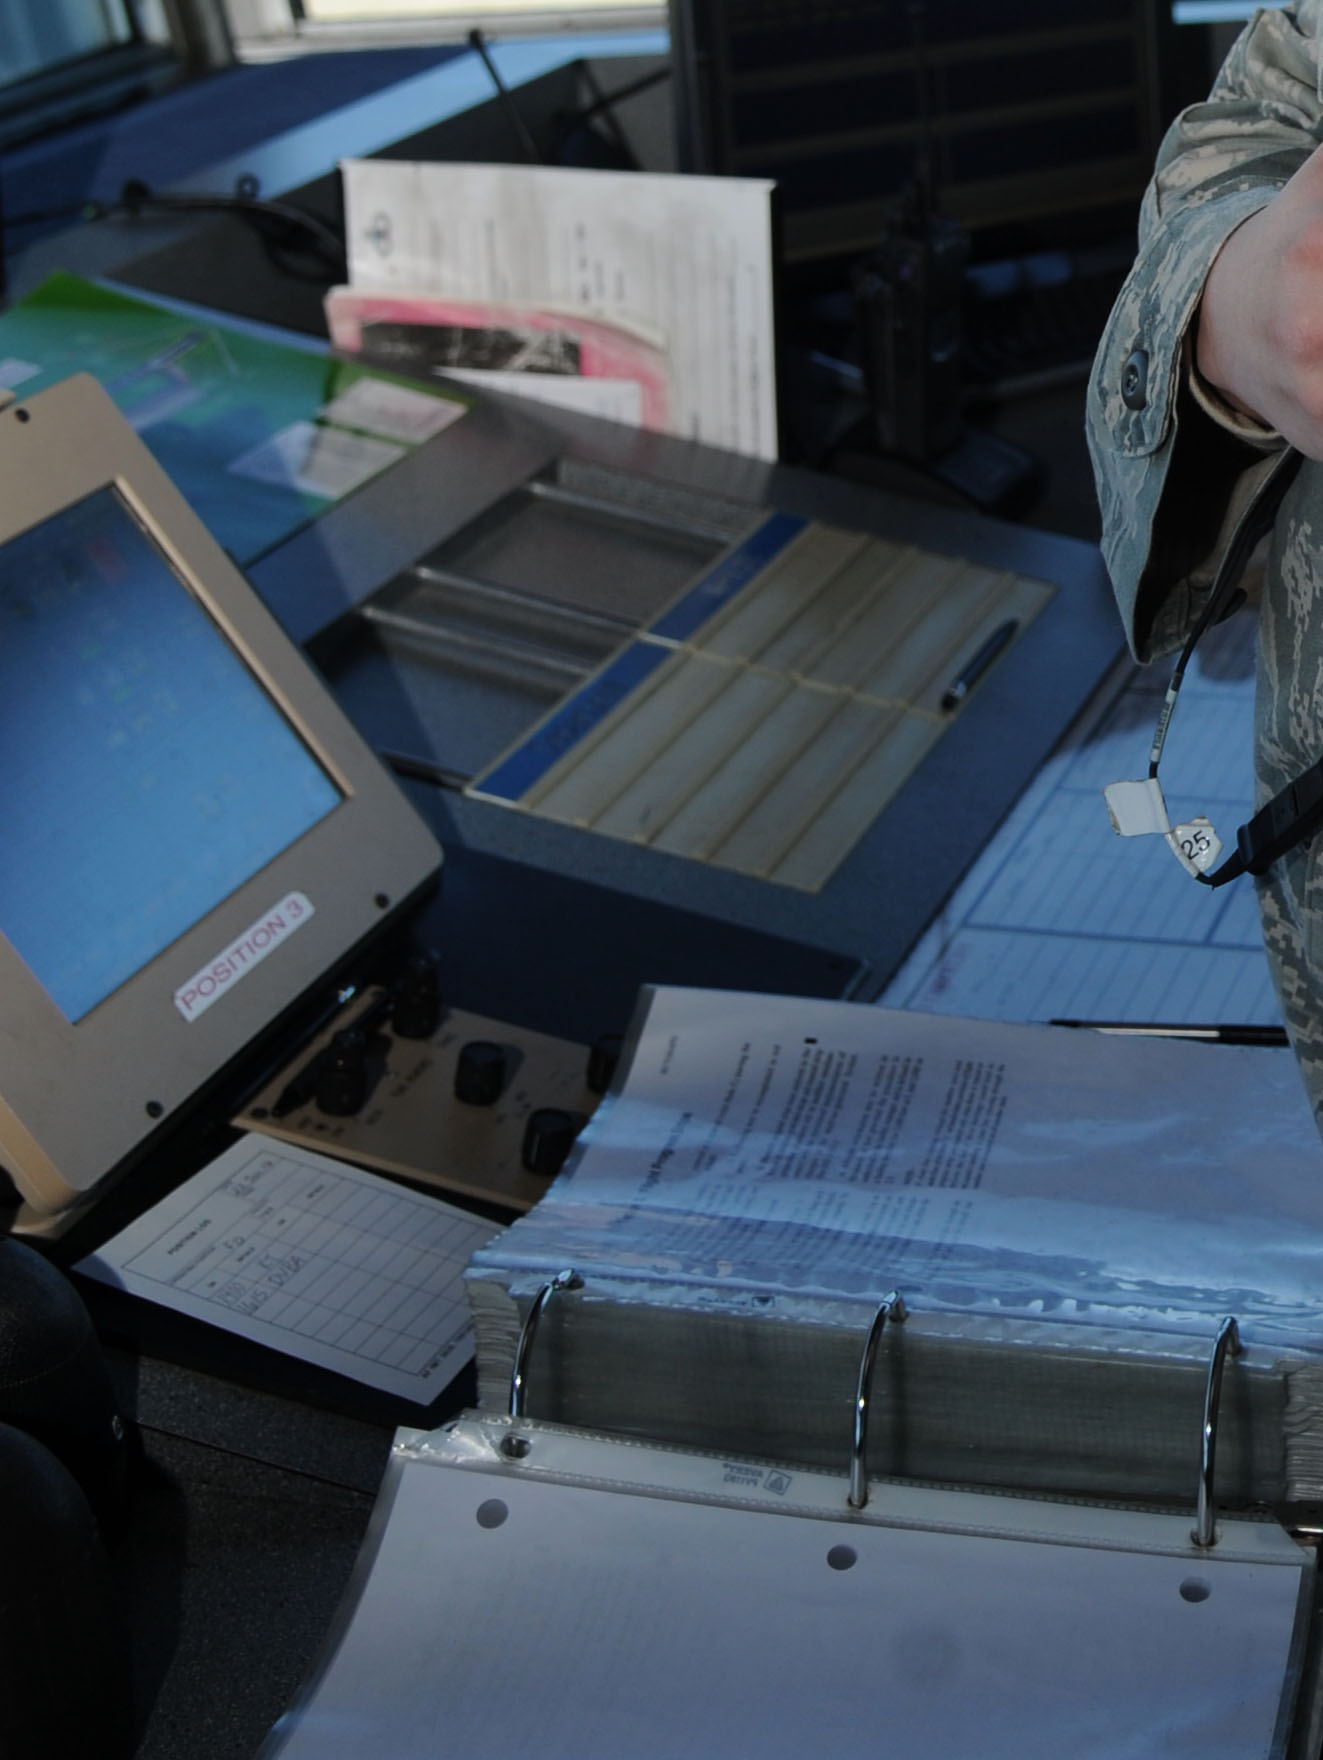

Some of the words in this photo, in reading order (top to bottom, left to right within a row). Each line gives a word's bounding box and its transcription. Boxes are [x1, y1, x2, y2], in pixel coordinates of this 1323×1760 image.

[1181, 830, 1211, 860] 25
[181, 914, 286, 1011] POSITION
[286, 899, 304, 919] 3
